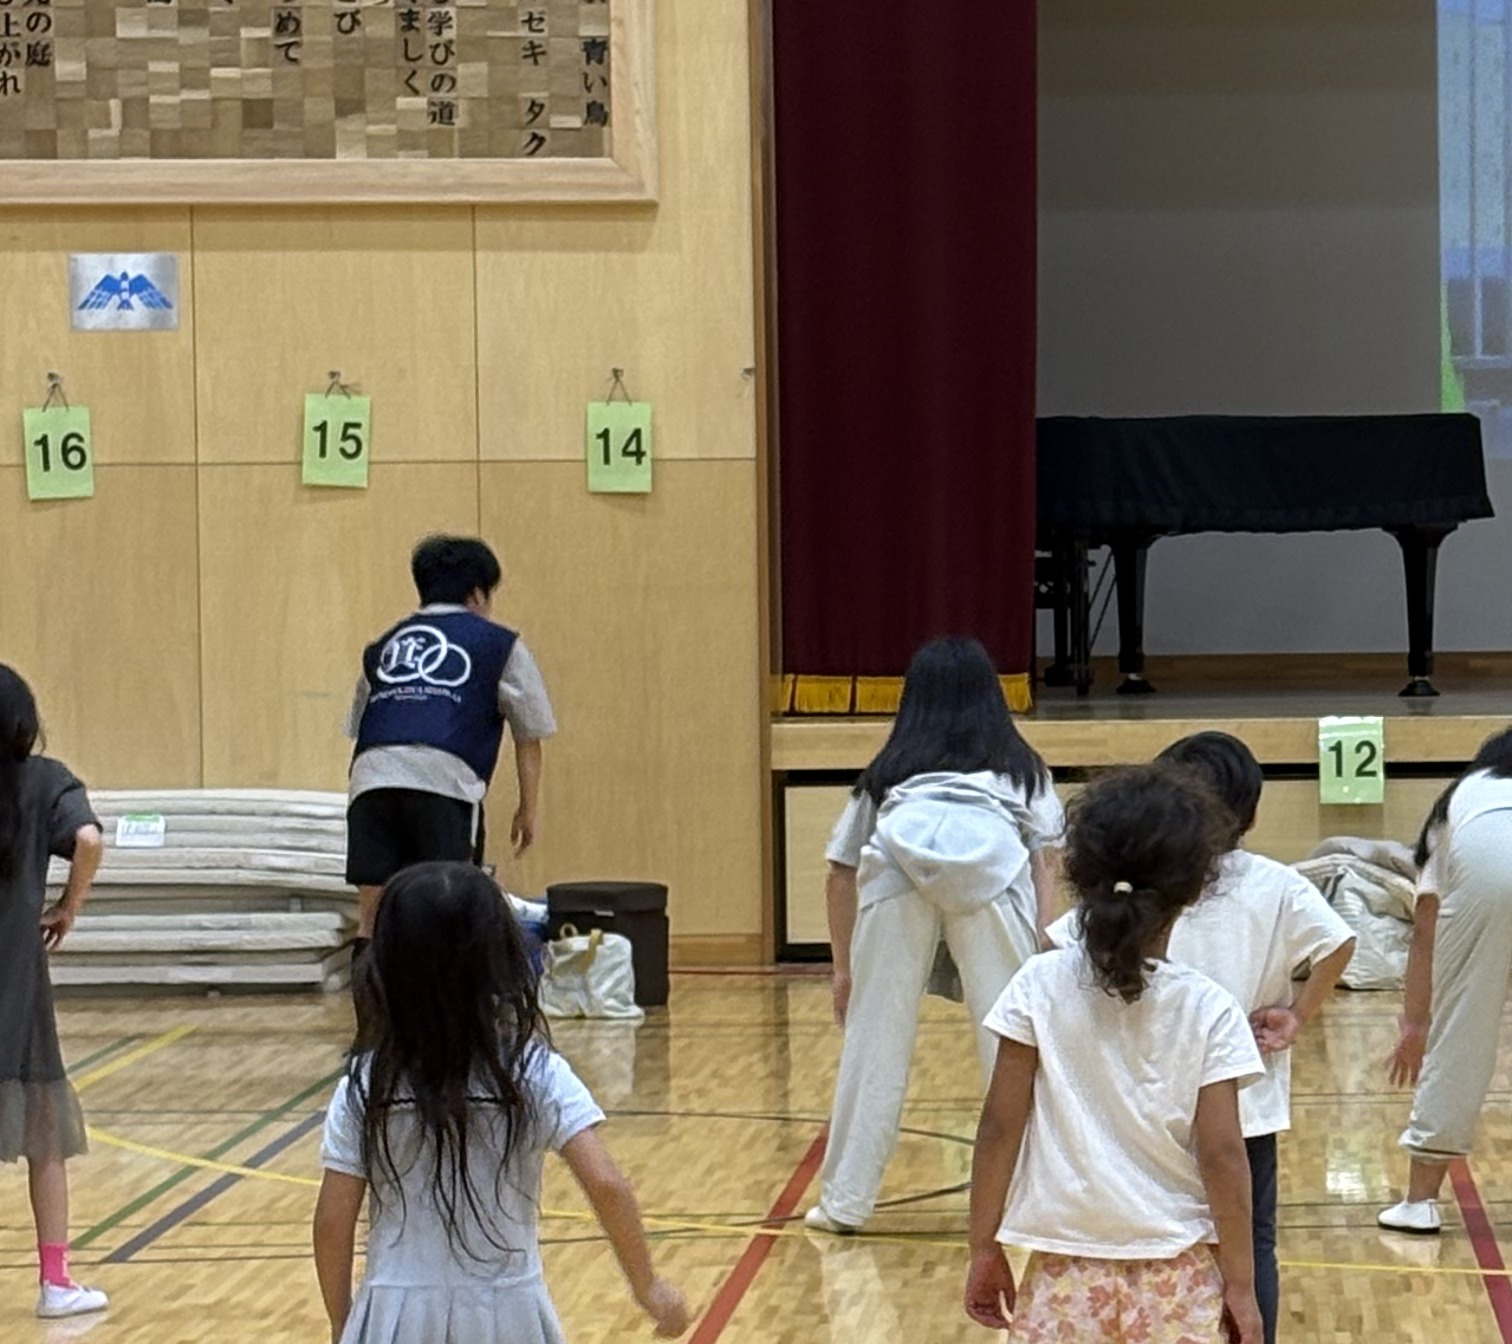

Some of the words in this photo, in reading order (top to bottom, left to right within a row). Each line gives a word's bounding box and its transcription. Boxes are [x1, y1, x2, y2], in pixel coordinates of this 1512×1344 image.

[582, 37, 609, 128] 青い鳥
[523, 100, 547, 156] タク
[33, 432, 87, 472] 16
[312, 421, 364, 459] 15
[595, 427, 646, 466] 14
[1327, 739, 1378, 778] 12
